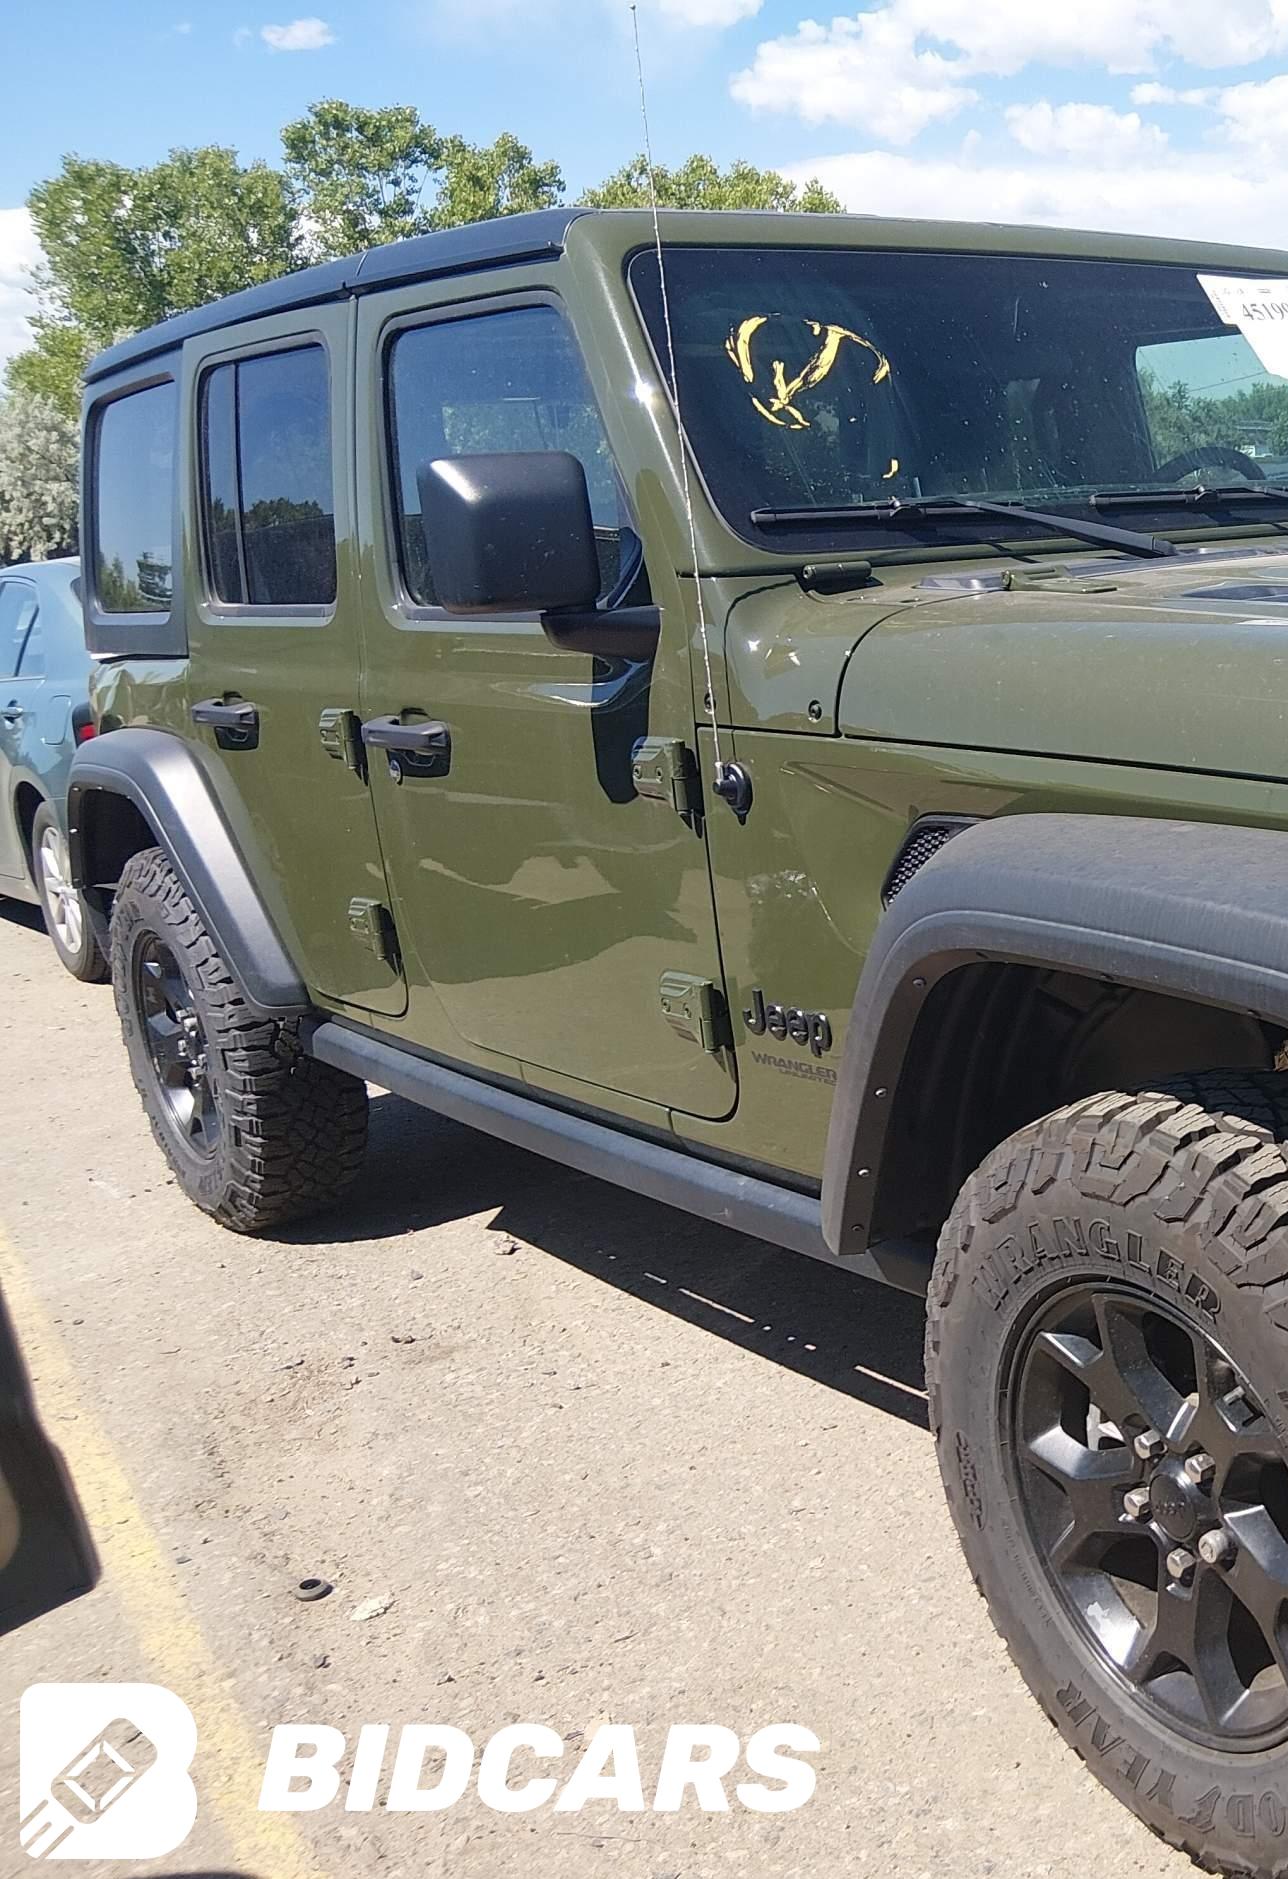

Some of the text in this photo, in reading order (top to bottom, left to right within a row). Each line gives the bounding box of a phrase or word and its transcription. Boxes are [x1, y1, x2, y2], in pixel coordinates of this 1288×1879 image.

[742, 987, 833, 1059] Jeep
[751, 1050, 838, 1081] WRANGLER
[970, 1216, 1222, 1325] WRANGLER
